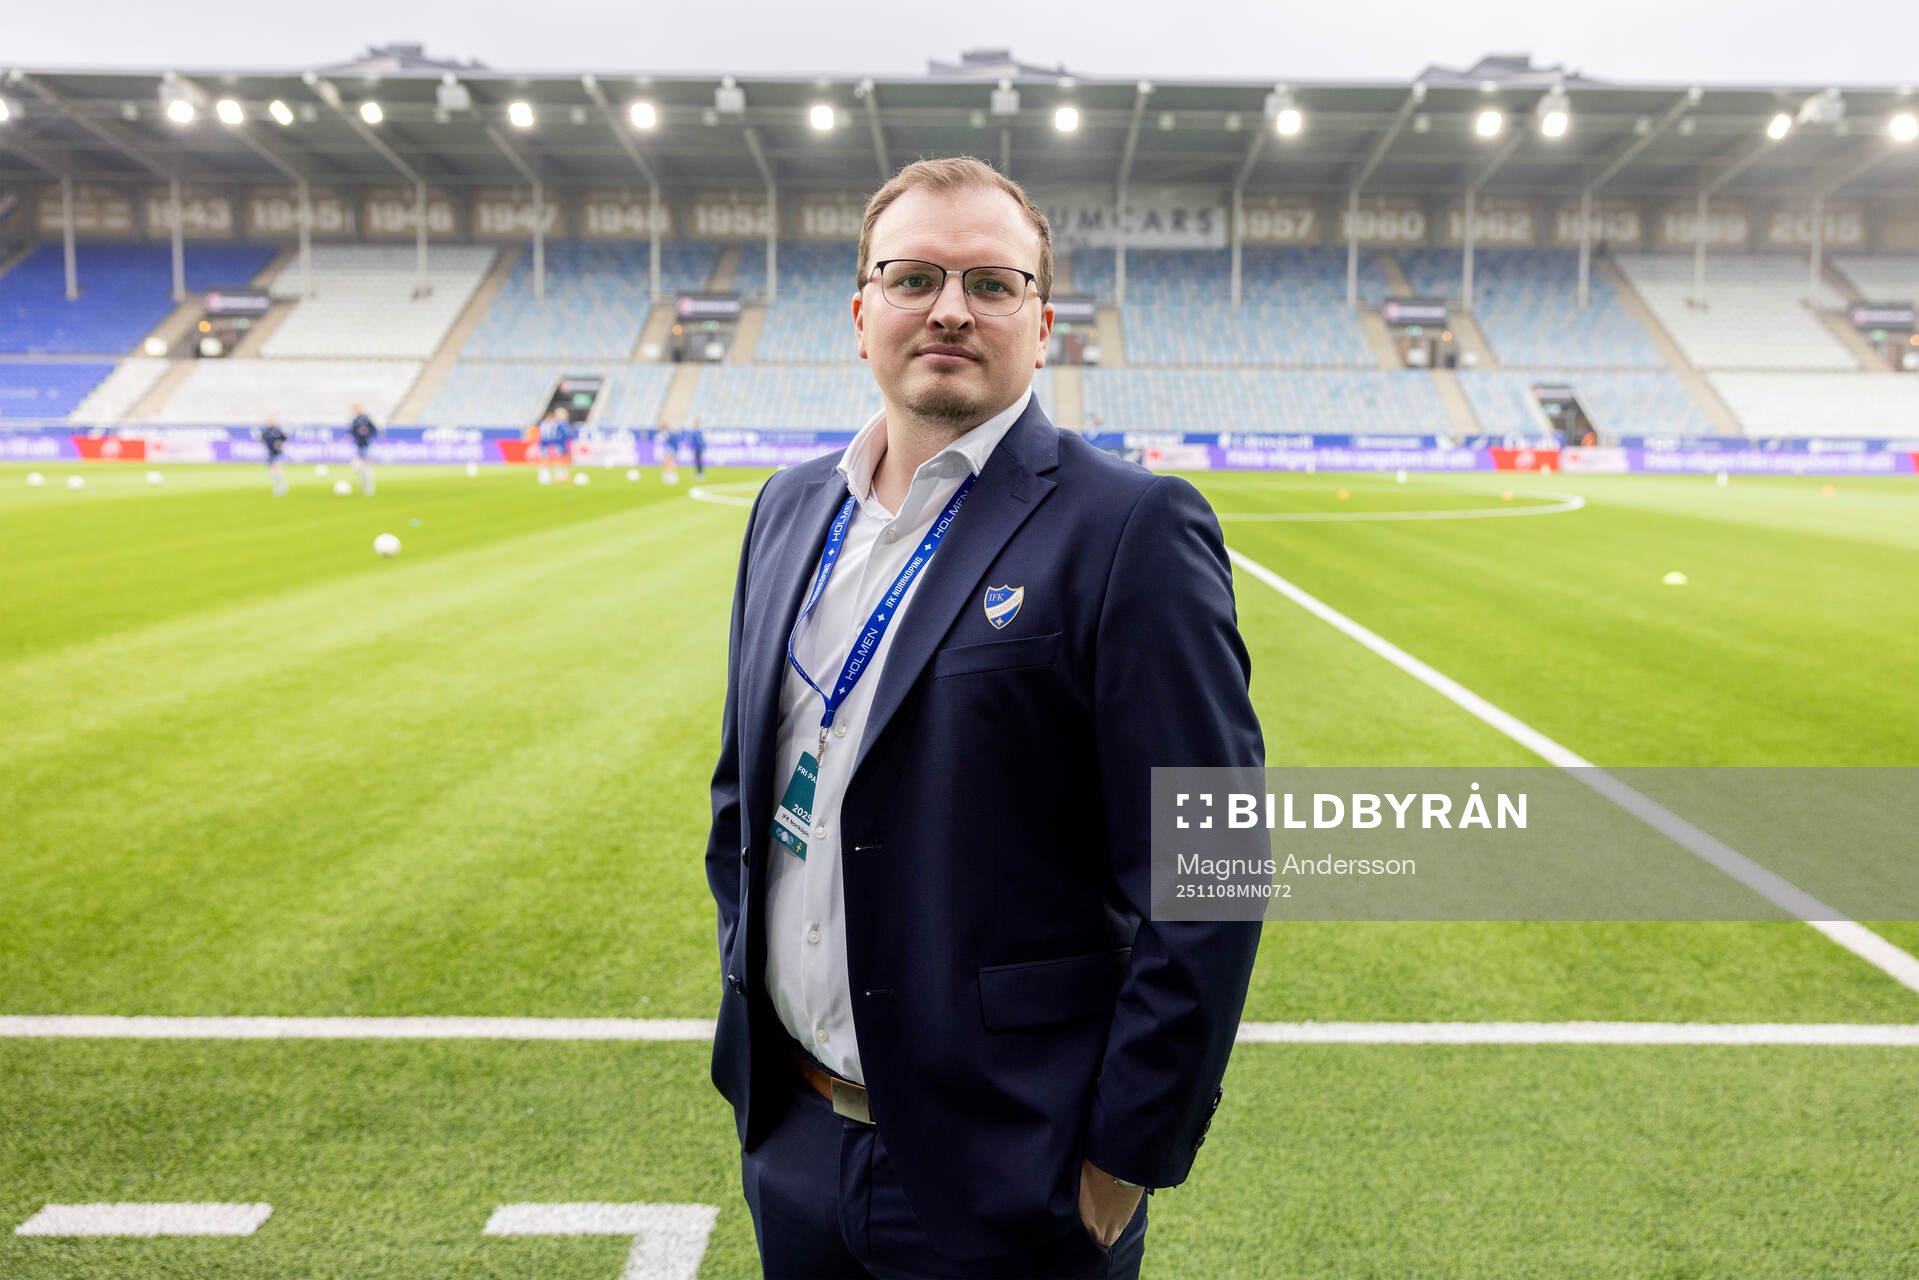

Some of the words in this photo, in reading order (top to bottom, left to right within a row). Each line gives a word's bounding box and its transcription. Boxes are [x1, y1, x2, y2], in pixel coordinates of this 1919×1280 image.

[478, 203, 558, 233] 1947
[801, 206, 864, 236] 195
[933, 490, 969, 538] HOLMEN
[885, 595, 897, 608] IFK
[988, 593, 1005, 602] IFK
[846, 627, 879, 681] HOLMEN
[797, 765, 808, 777] FRI
[792, 804, 812, 823] 2025
